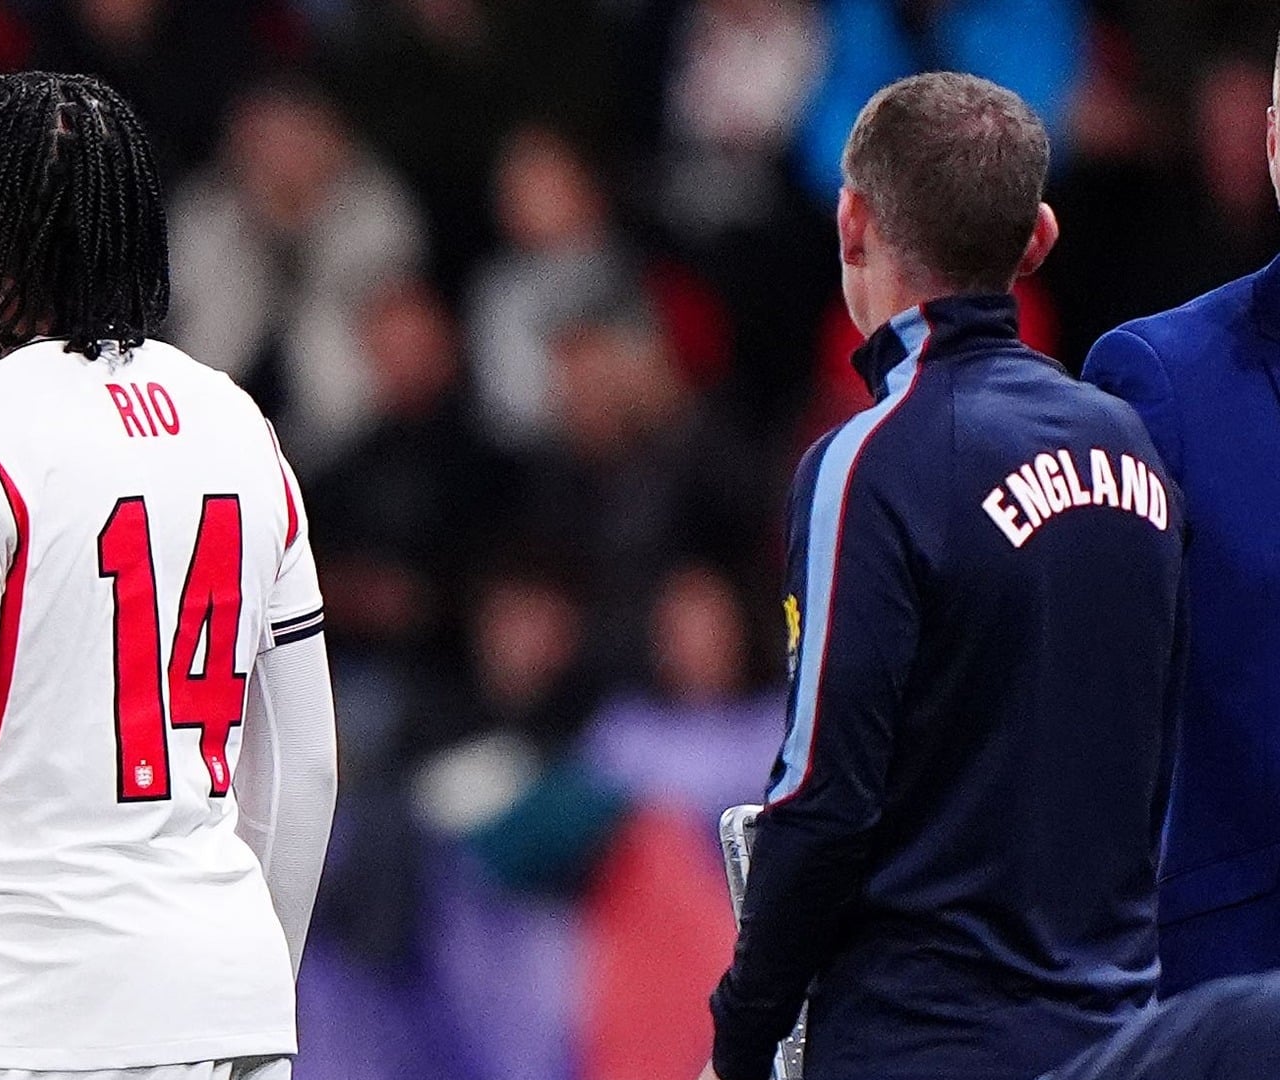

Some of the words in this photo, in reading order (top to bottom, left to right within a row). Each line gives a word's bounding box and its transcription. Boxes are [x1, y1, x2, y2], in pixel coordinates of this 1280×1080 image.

[104, 382, 179, 437] RIO
[981, 448, 1168, 548] ENGLAND
[97, 494, 247, 803] 14
